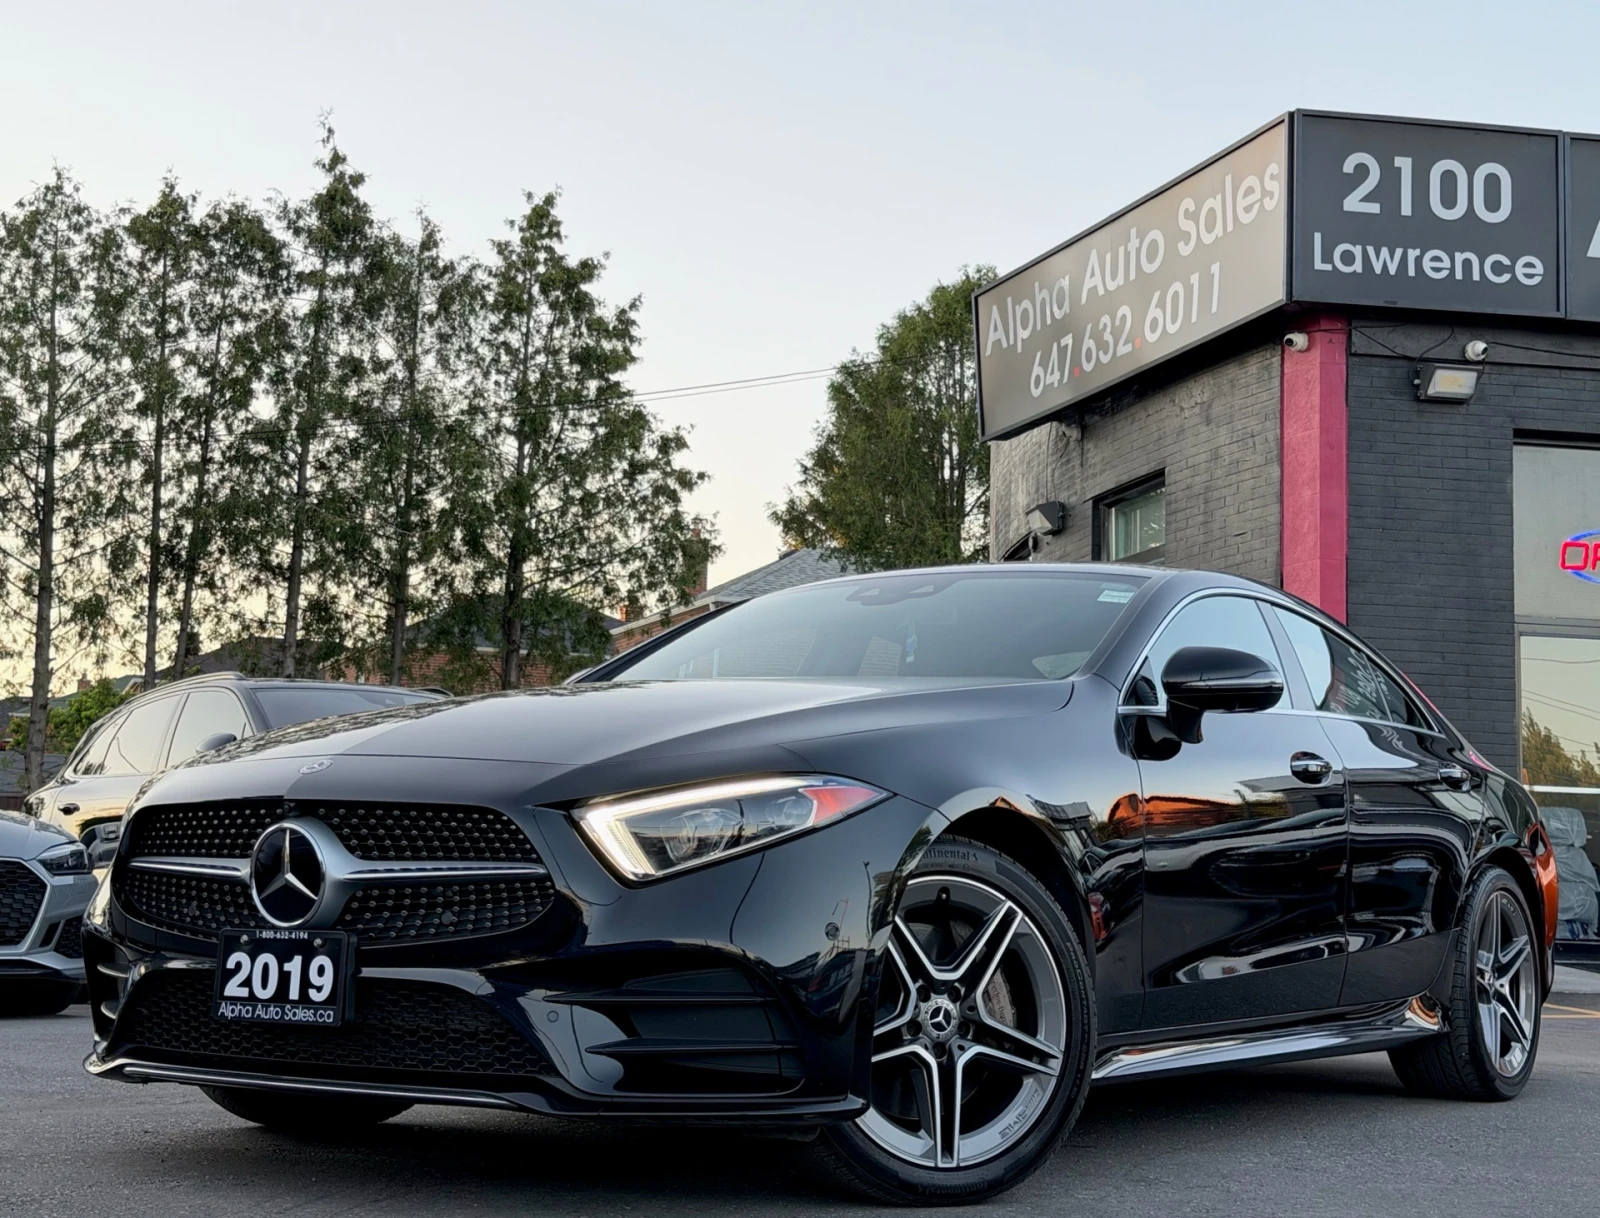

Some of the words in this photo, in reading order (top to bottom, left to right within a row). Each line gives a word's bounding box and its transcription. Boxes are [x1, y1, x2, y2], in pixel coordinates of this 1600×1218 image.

[1342, 152, 1512, 223] 2100
[985, 275, 1070, 357] Alpha
[1081, 228, 1165, 304] Auto
[1177, 161, 1281, 257] Sales
[1313, 232, 1544, 286] Lawrence
[1029, 262, 1221, 398] 647.632.6011
[224, 952, 334, 1002] 2019
[218, 1002, 252, 1020] Alpha
[254, 1004, 281, 1019] Auto
[284, 1005, 334, 1022] Sales.ca
